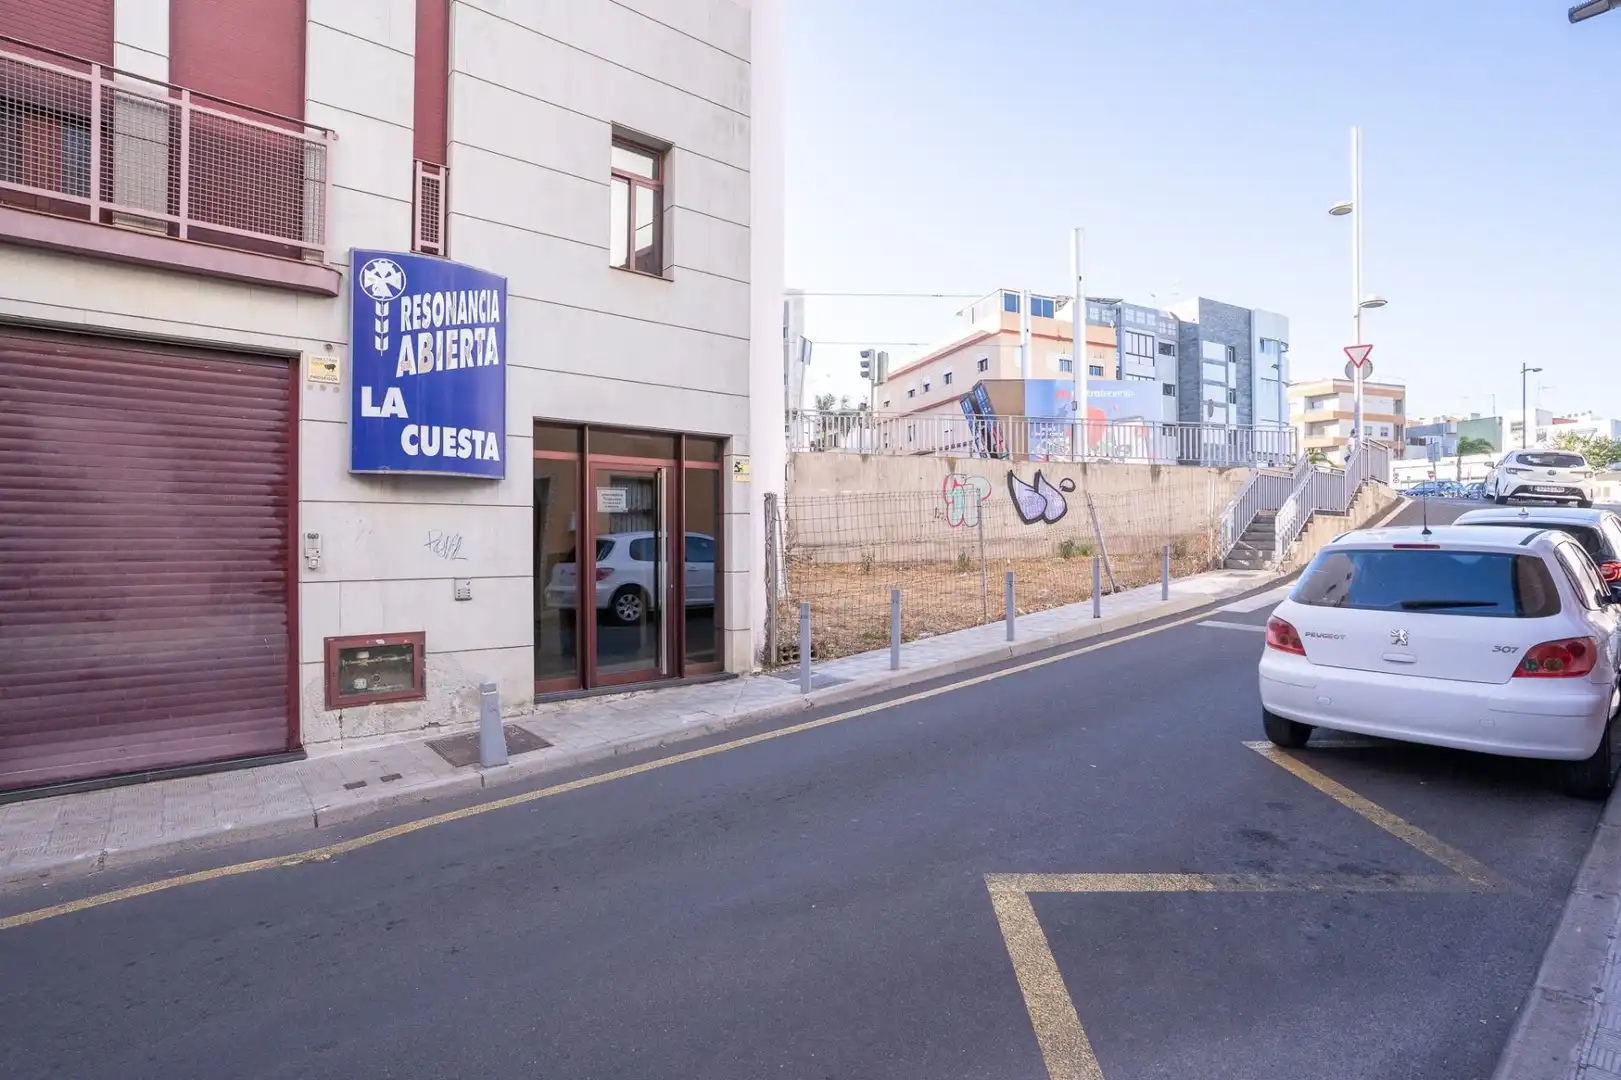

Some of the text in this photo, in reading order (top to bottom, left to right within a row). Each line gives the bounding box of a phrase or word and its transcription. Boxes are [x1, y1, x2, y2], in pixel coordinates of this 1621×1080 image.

[400, 289, 500, 332] RESONANCIA
[395, 327, 499, 378] ABIERTA
[361, 386, 409, 418] LA
[401, 424, 500, 462] CUESTA
[1305, 631, 1347, 640] PEUGEOT
[1491, 645, 1519, 654] 307
